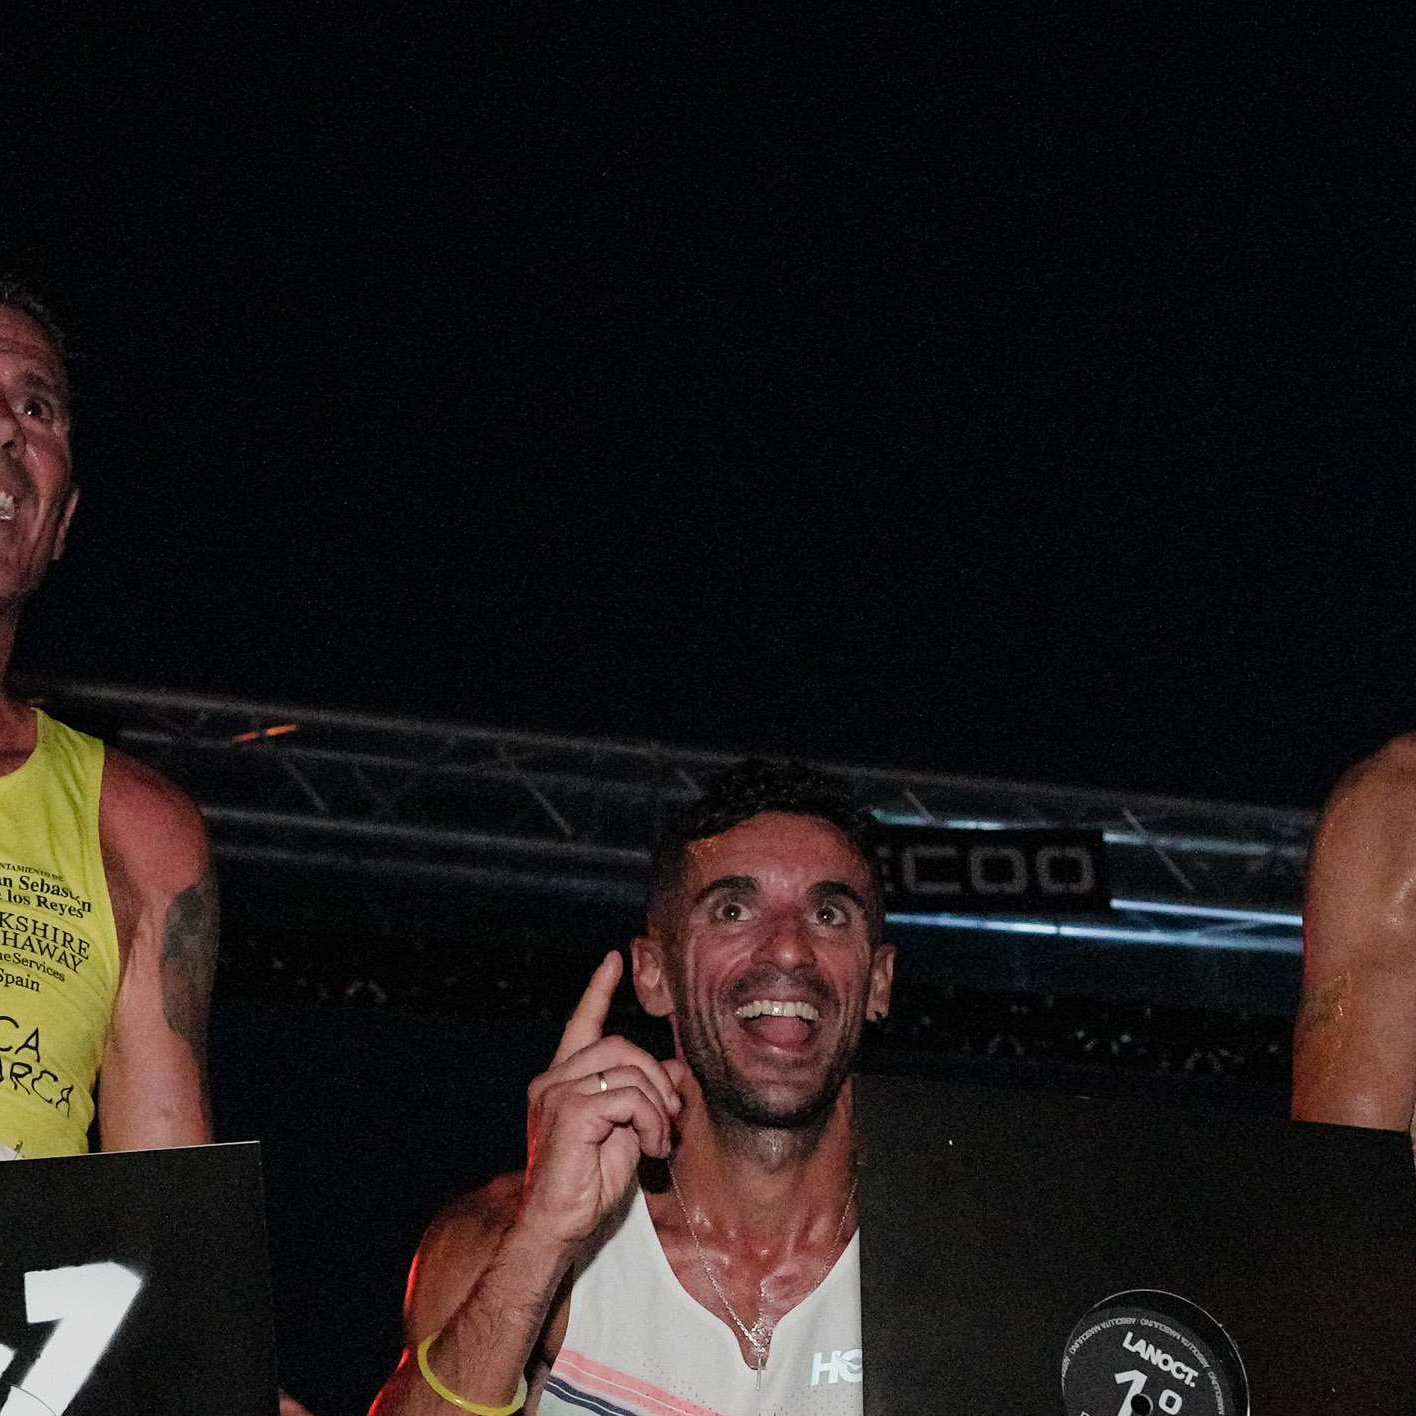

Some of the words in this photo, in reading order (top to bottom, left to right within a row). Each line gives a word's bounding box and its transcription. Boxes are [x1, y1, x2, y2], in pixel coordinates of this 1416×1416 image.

[878, 843, 1096, 897] COO
[7, 890, 31, 906] los
[36, 894, 84, 919] Reyes
